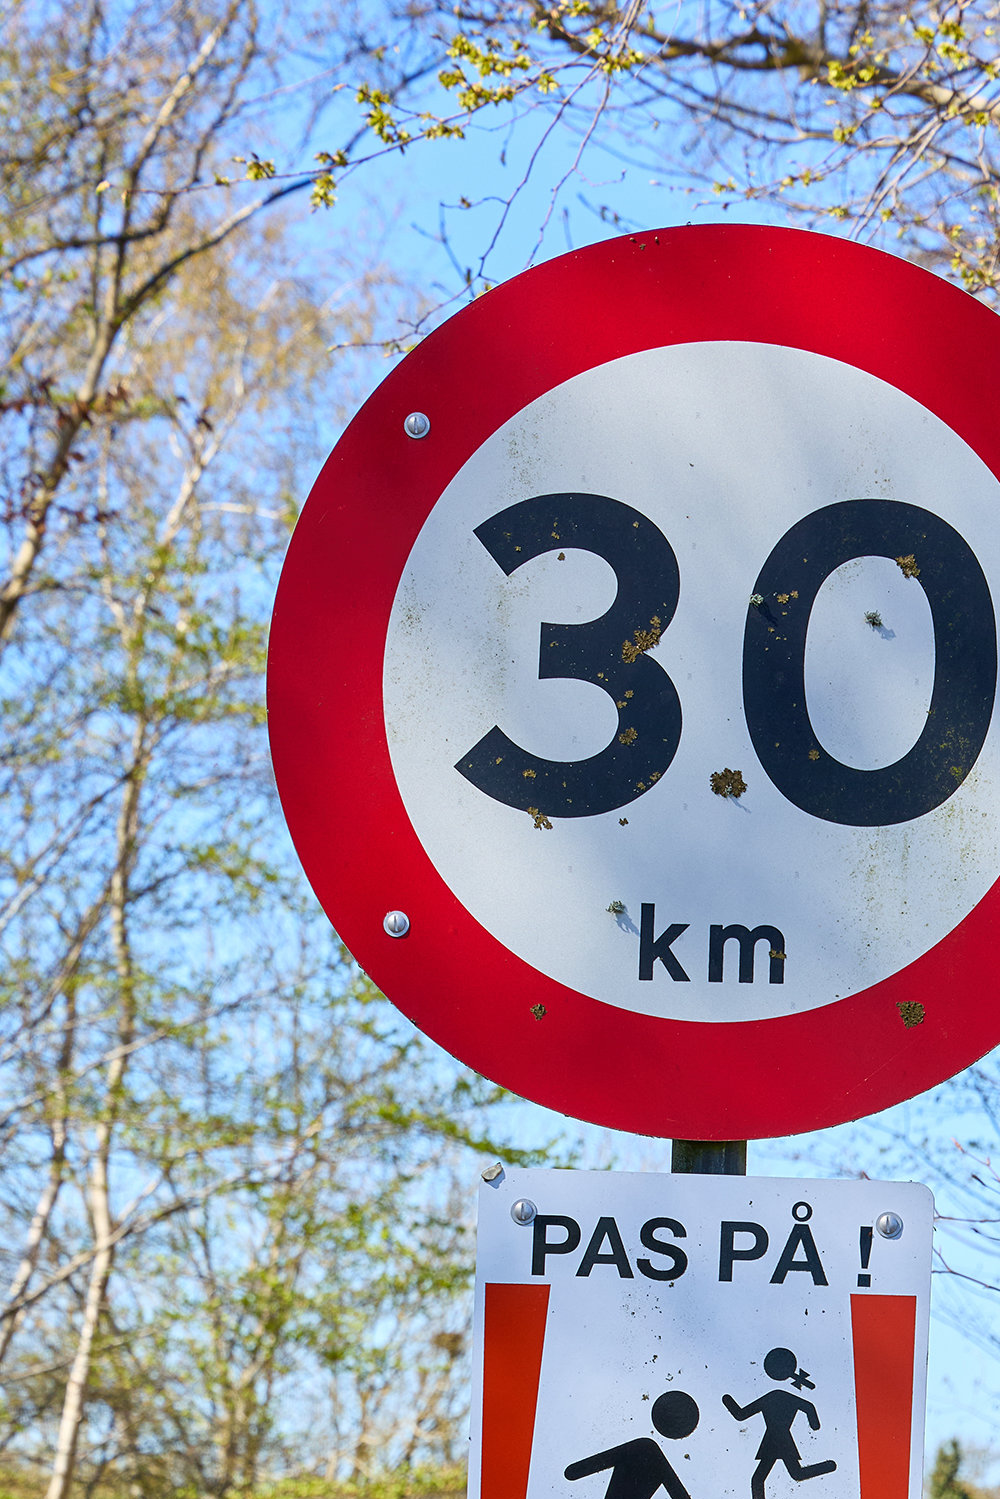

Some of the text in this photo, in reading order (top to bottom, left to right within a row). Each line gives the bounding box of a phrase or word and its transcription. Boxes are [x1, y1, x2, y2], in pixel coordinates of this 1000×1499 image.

[454, 493, 998, 826] 30
[638, 902, 788, 985] km
[531, 1214, 689, 1283] PAS
[718, 1201, 830, 1288] PÅ
